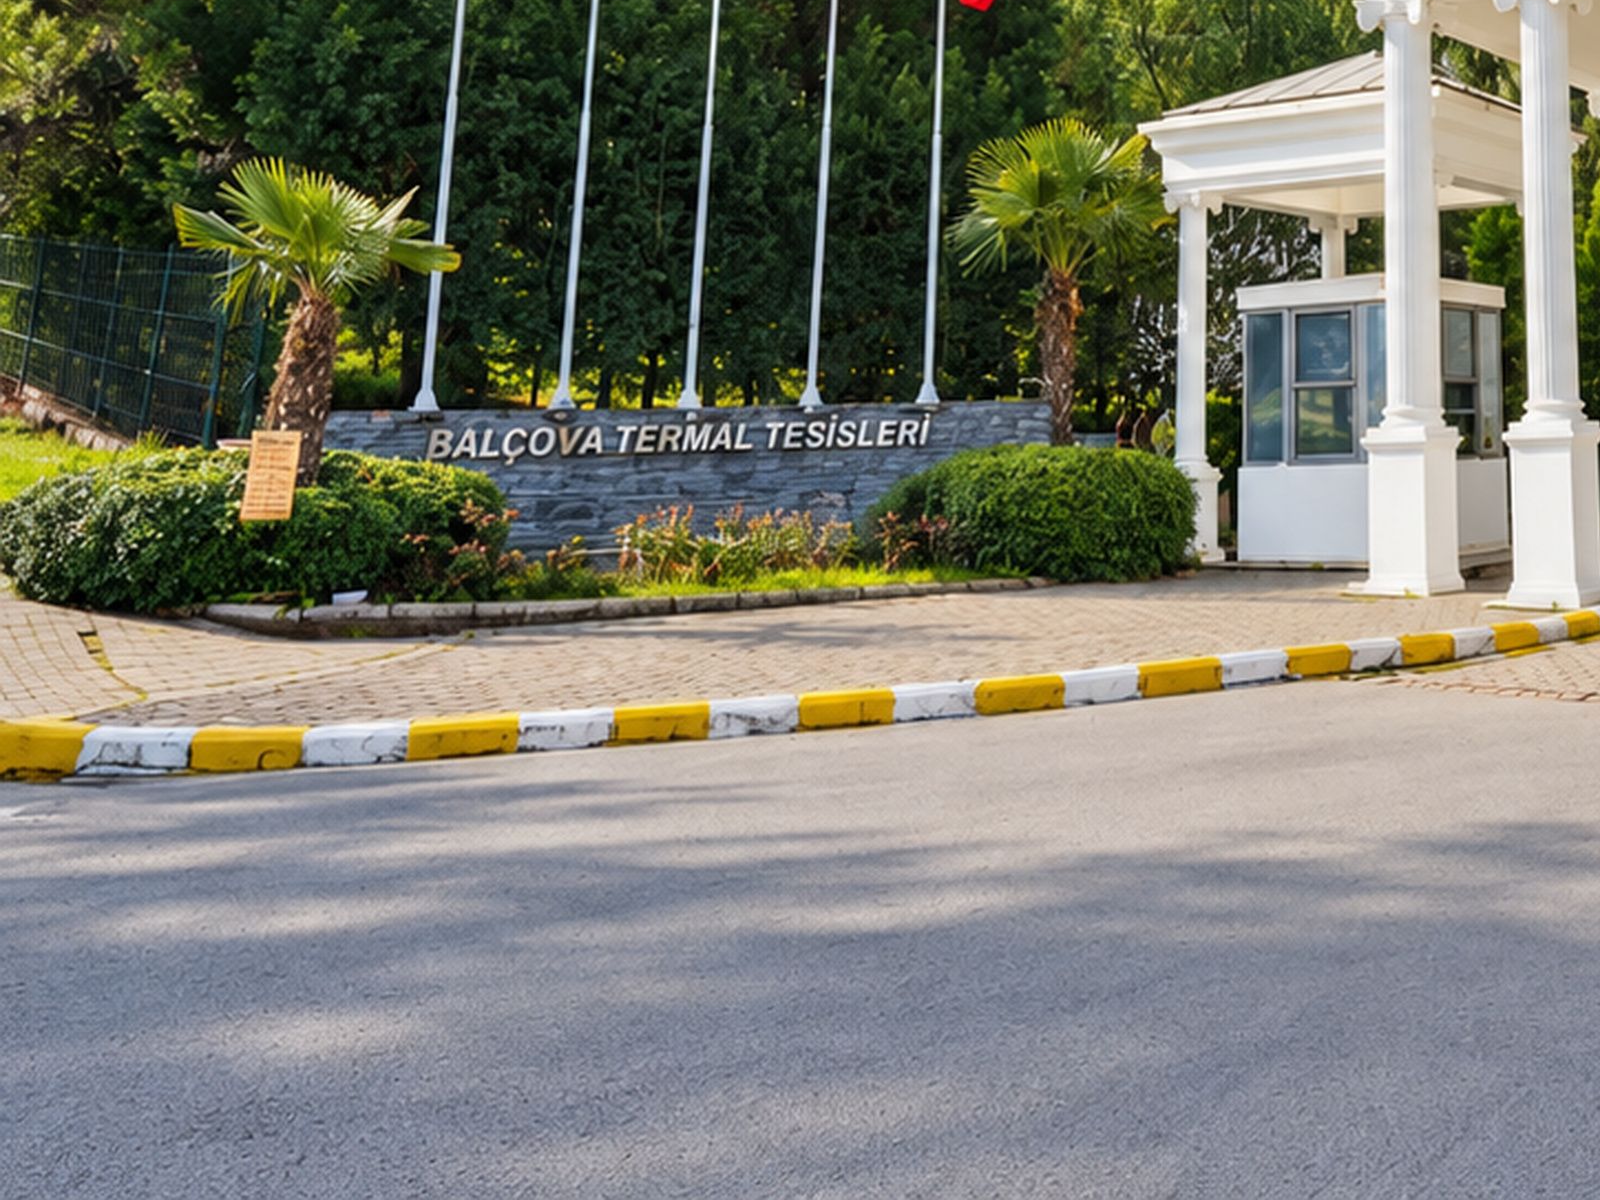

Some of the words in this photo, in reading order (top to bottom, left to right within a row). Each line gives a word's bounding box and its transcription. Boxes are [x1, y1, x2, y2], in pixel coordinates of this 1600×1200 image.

[428, 424, 603, 466] BALÇOVA
[616, 421, 753, 454] TERMAL
[765, 412, 931, 449] TESİSLERİ
